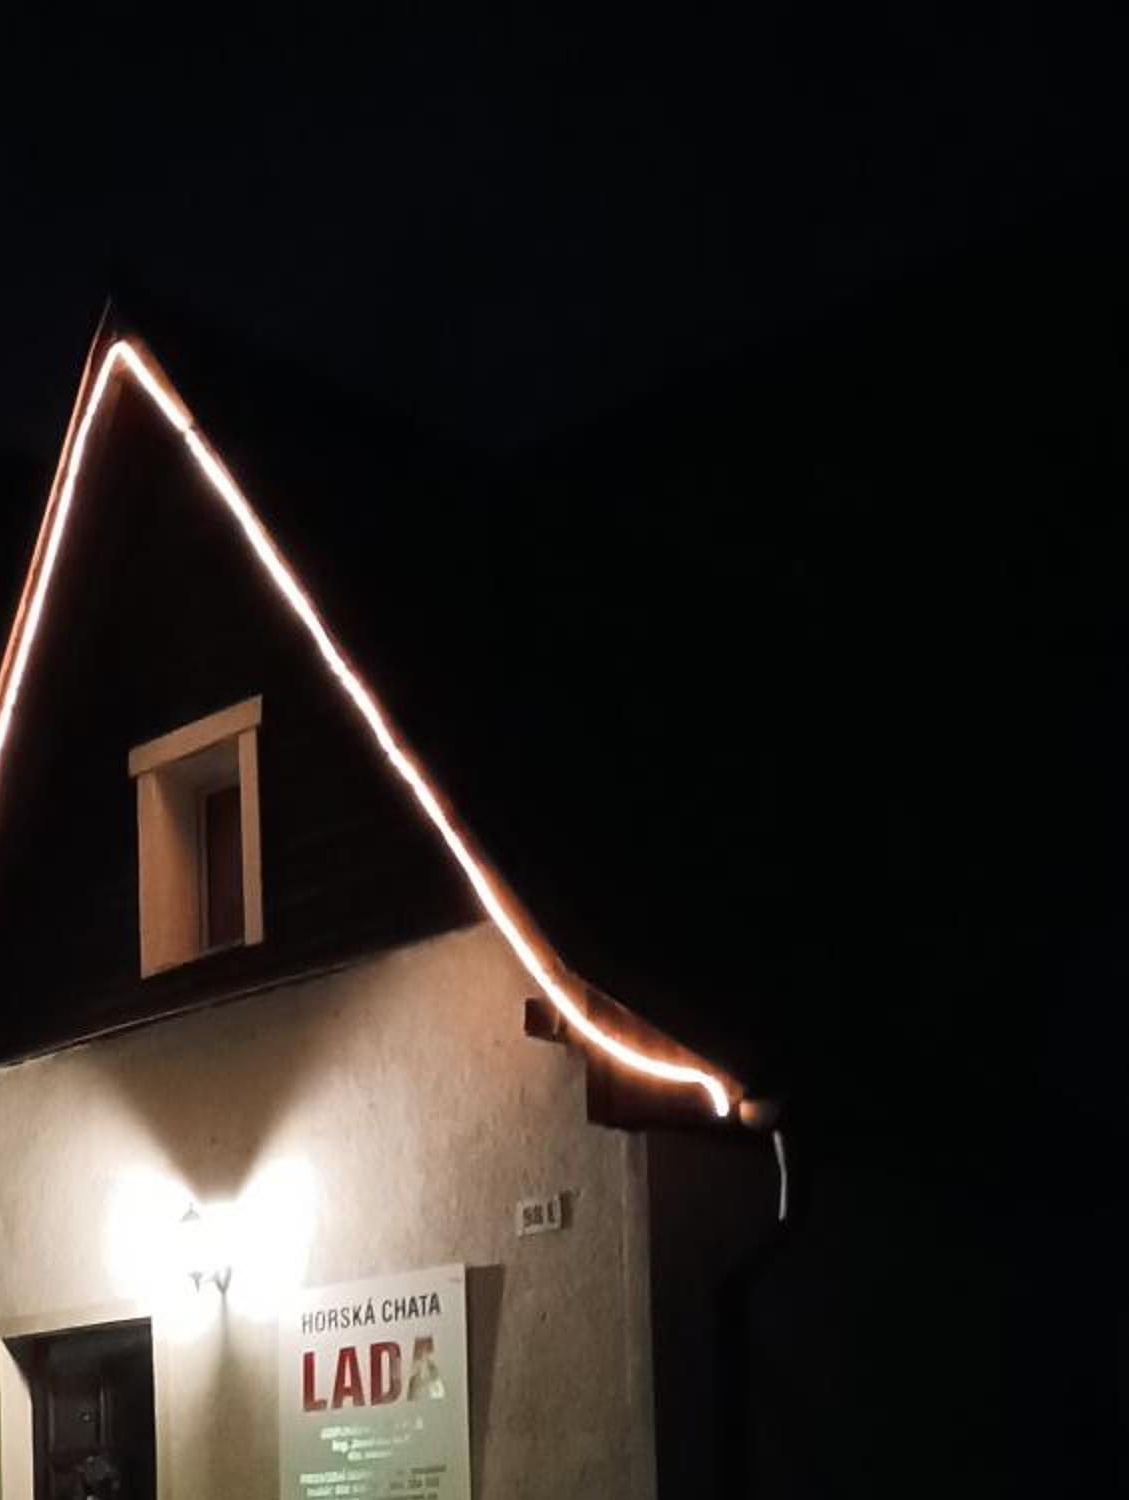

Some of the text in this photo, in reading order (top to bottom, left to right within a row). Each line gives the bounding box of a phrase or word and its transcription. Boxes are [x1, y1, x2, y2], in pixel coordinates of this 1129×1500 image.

[302, 1292, 442, 1334] HORSKÁ CHATA
[303, 1335, 446, 1413] LADA
